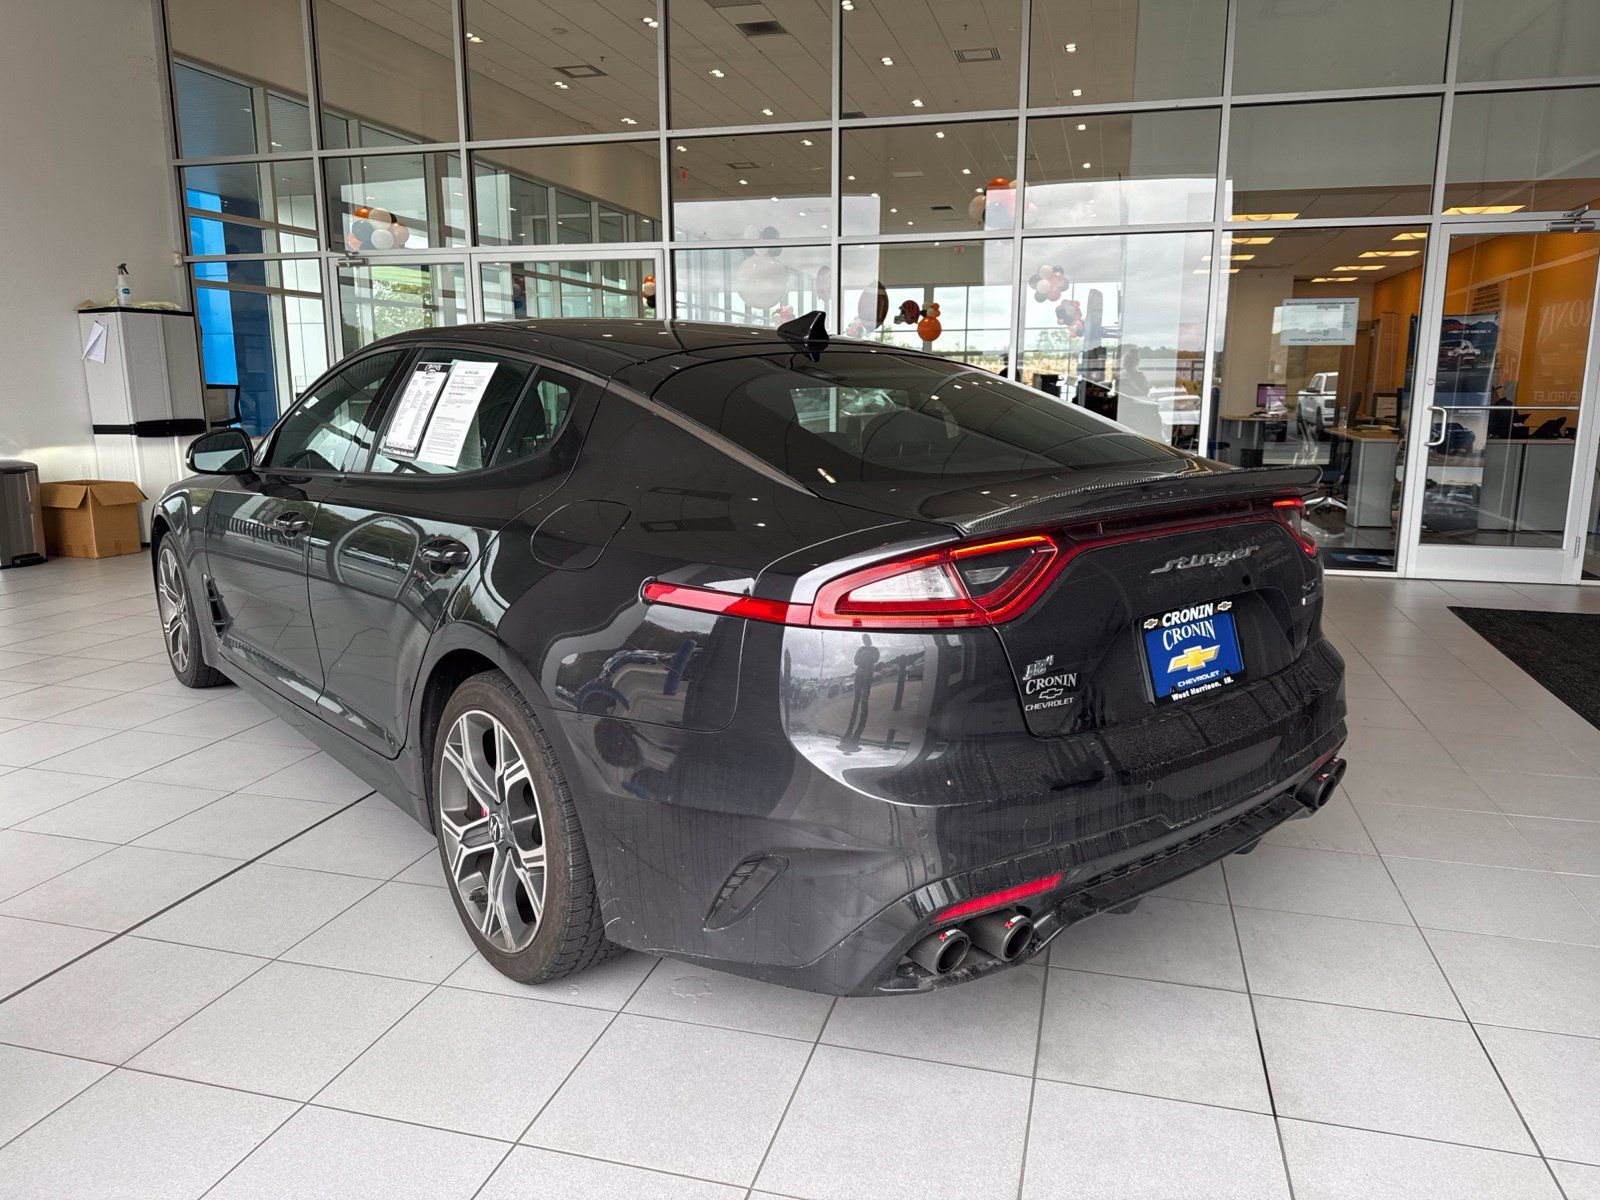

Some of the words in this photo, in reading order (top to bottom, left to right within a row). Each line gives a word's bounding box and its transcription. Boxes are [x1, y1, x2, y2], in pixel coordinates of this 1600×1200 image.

[1161, 602, 1215, 628] CRONIN
[1162, 619, 1217, 651] CRONIN
[1025, 672, 1078, 695] CRONIN
[1177, 669, 1221, 688] CHEVROLET
[1025, 696, 1075, 711] CHEVROLET
[1171, 690, 1190, 702] West
